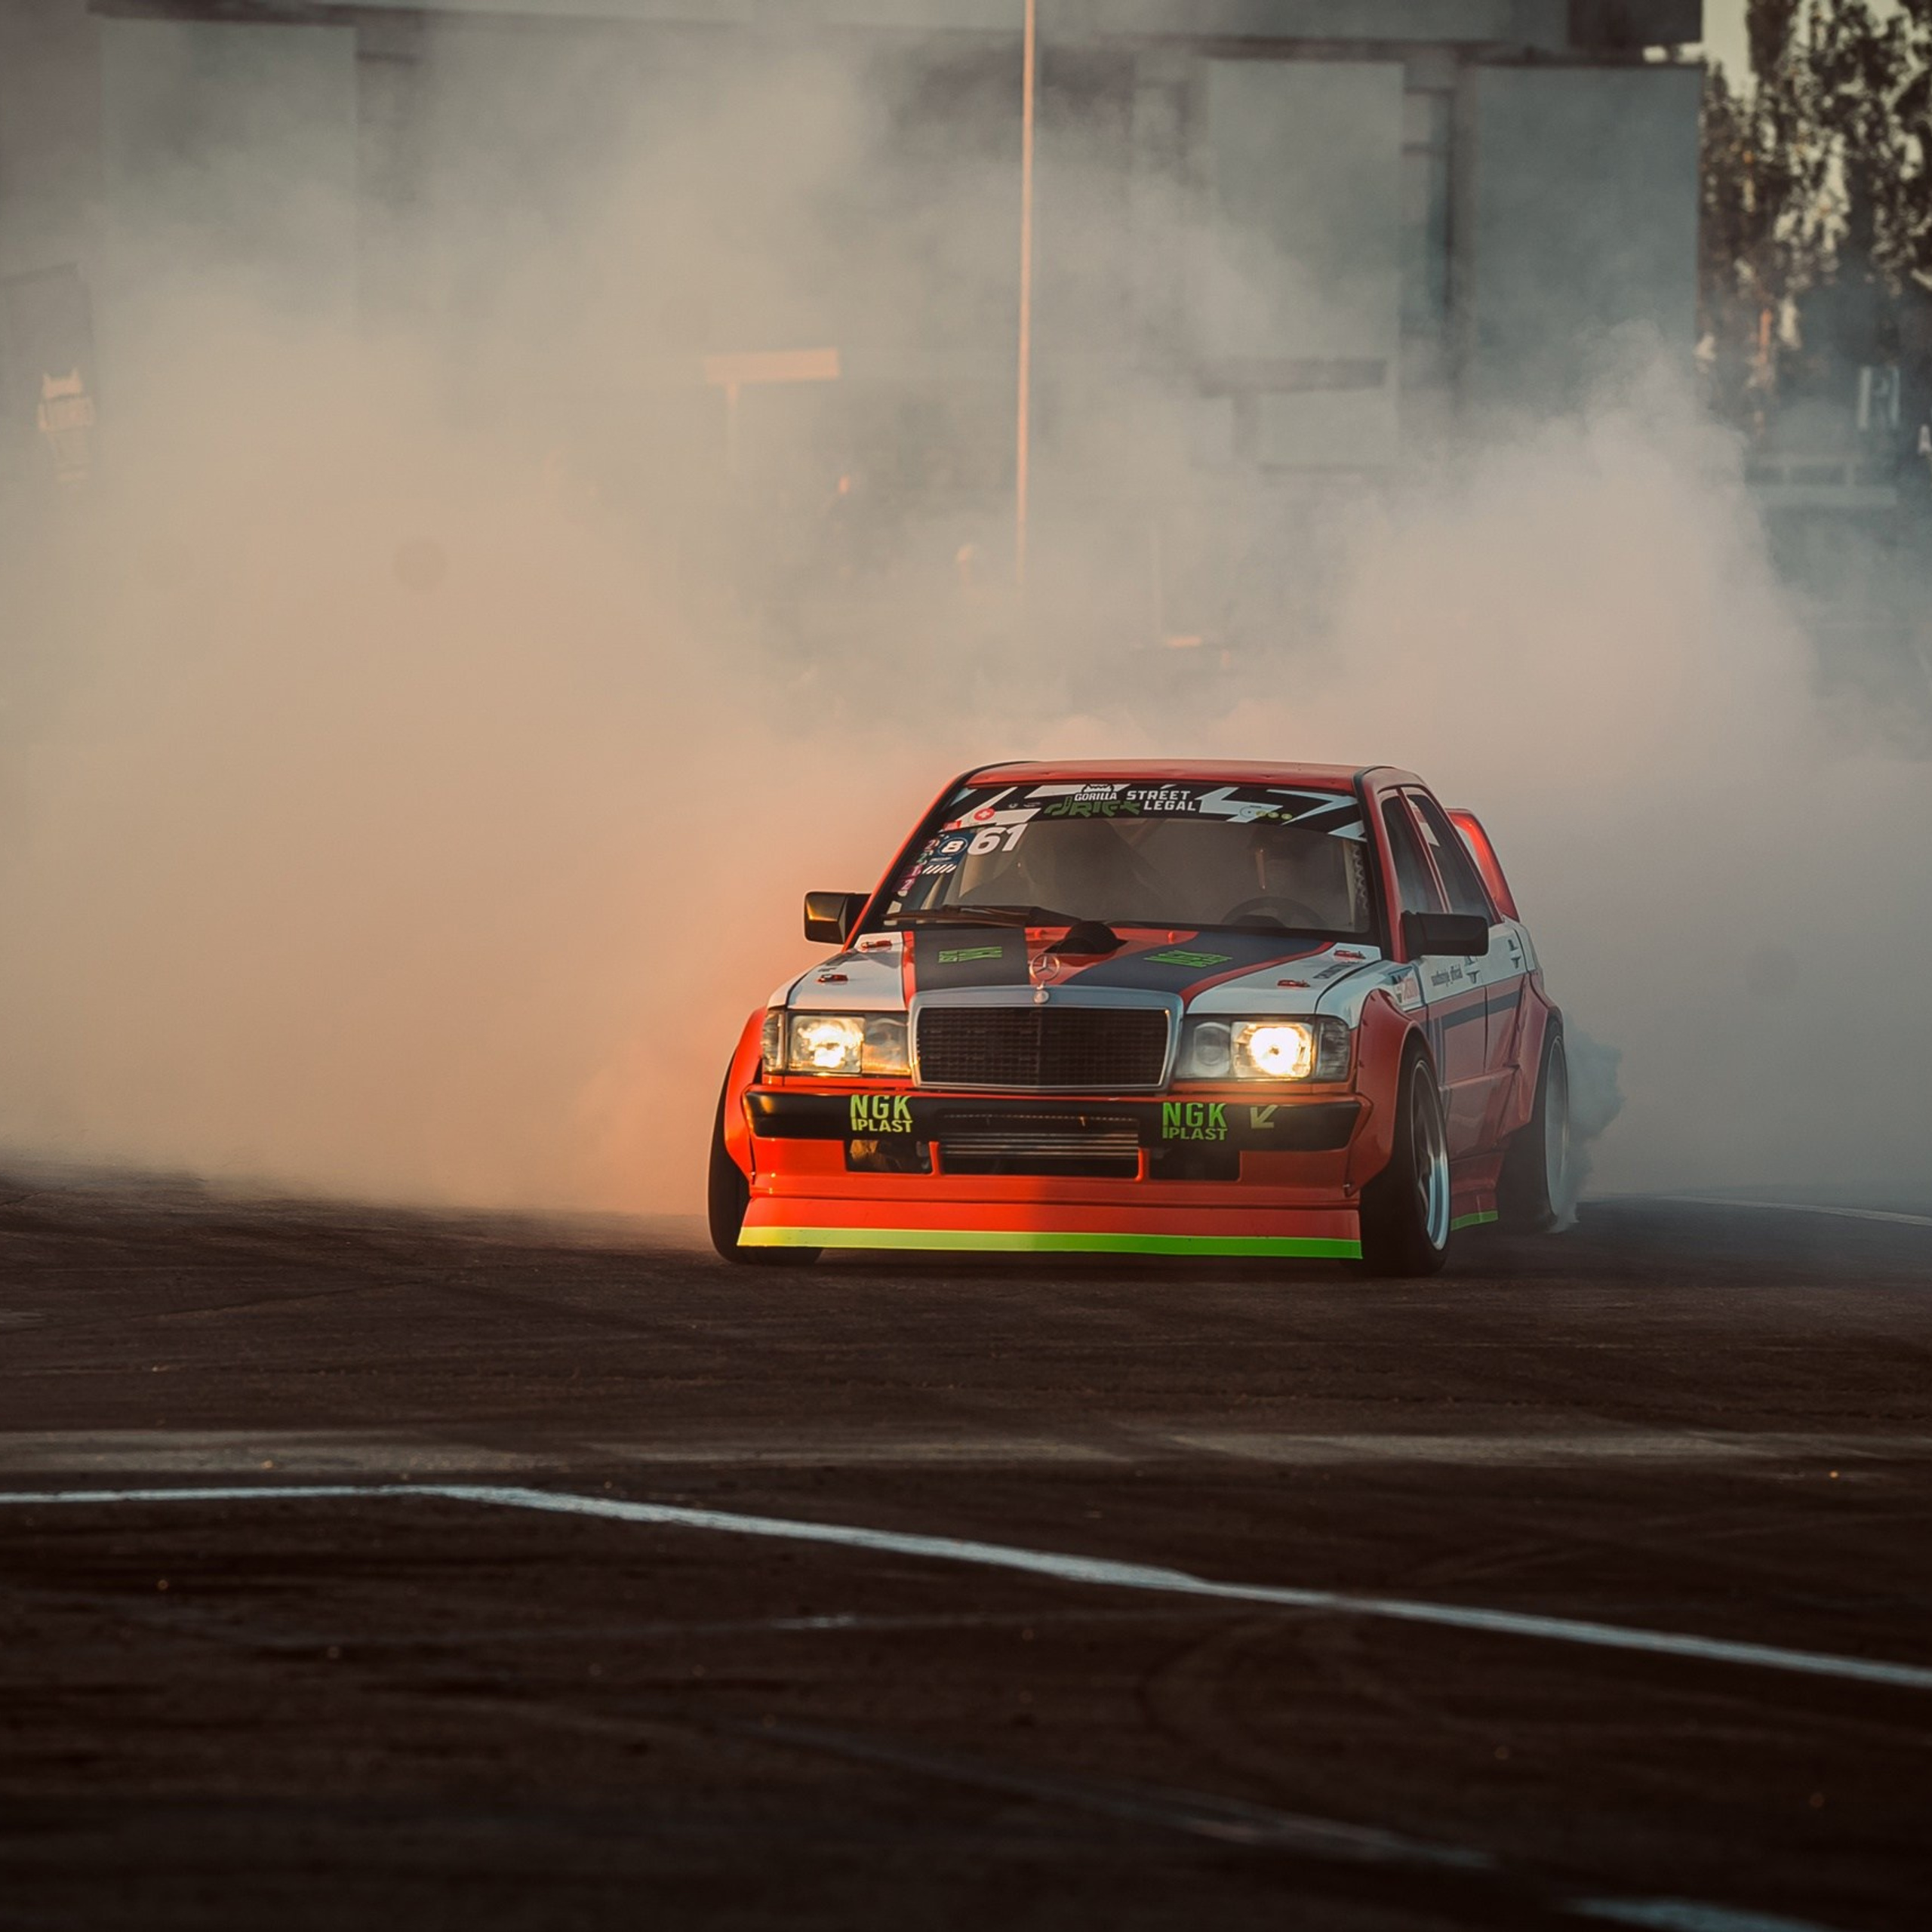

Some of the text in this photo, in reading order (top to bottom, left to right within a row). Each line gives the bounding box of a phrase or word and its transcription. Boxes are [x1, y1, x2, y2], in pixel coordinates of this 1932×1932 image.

[1074, 792, 1118, 801] GORILLA
[1126, 790, 1191, 801] STREET
[1143, 800, 1196, 811] LEGAL
[968, 823, 1029, 856] 61
[941, 840, 964, 854] 8
[850, 1094, 912, 1120] NGK
[1162, 1102, 1227, 1128] NGK
